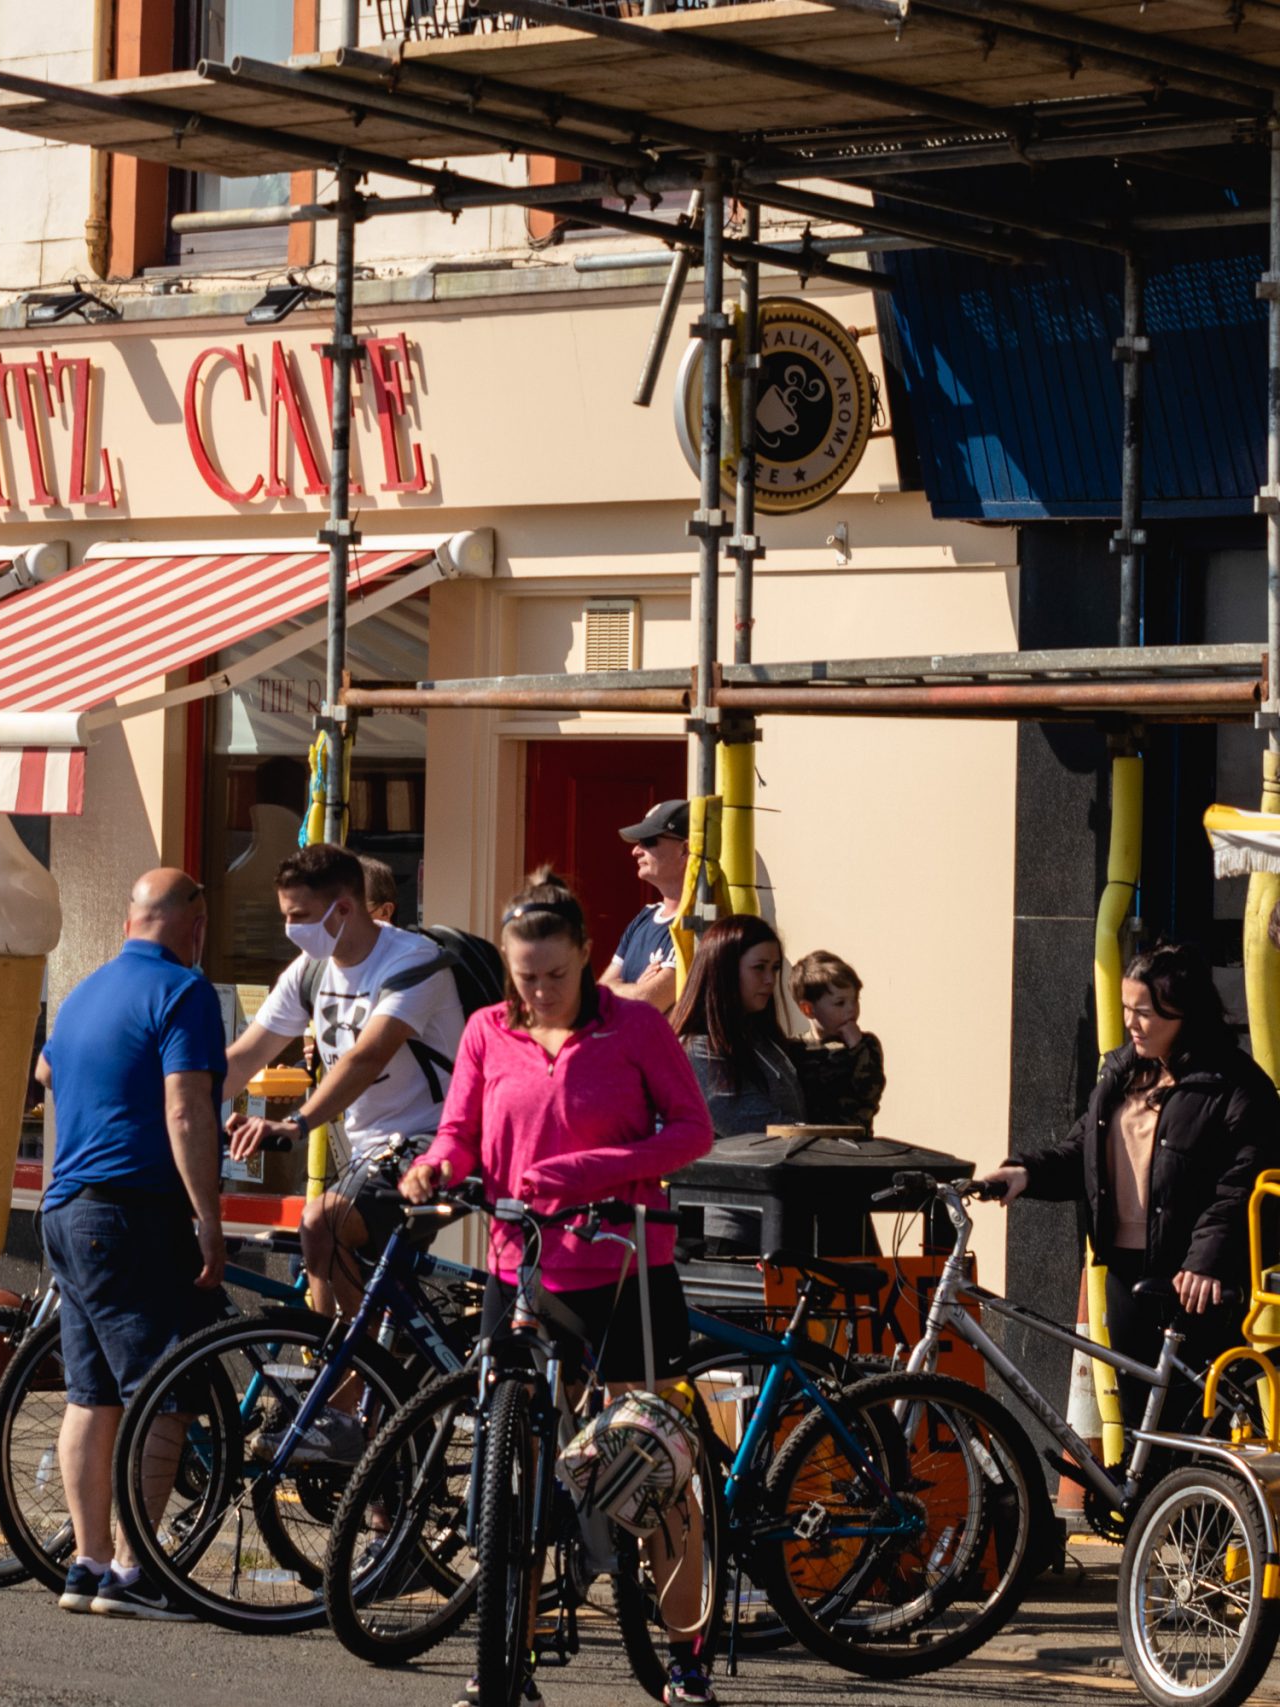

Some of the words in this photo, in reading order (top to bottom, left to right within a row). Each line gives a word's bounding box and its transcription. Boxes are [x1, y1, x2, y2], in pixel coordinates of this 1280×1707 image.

[760, 330, 836, 367] TALIAN
[824, 376, 852, 460] AROMA
[257, 679, 295, 713] THE
